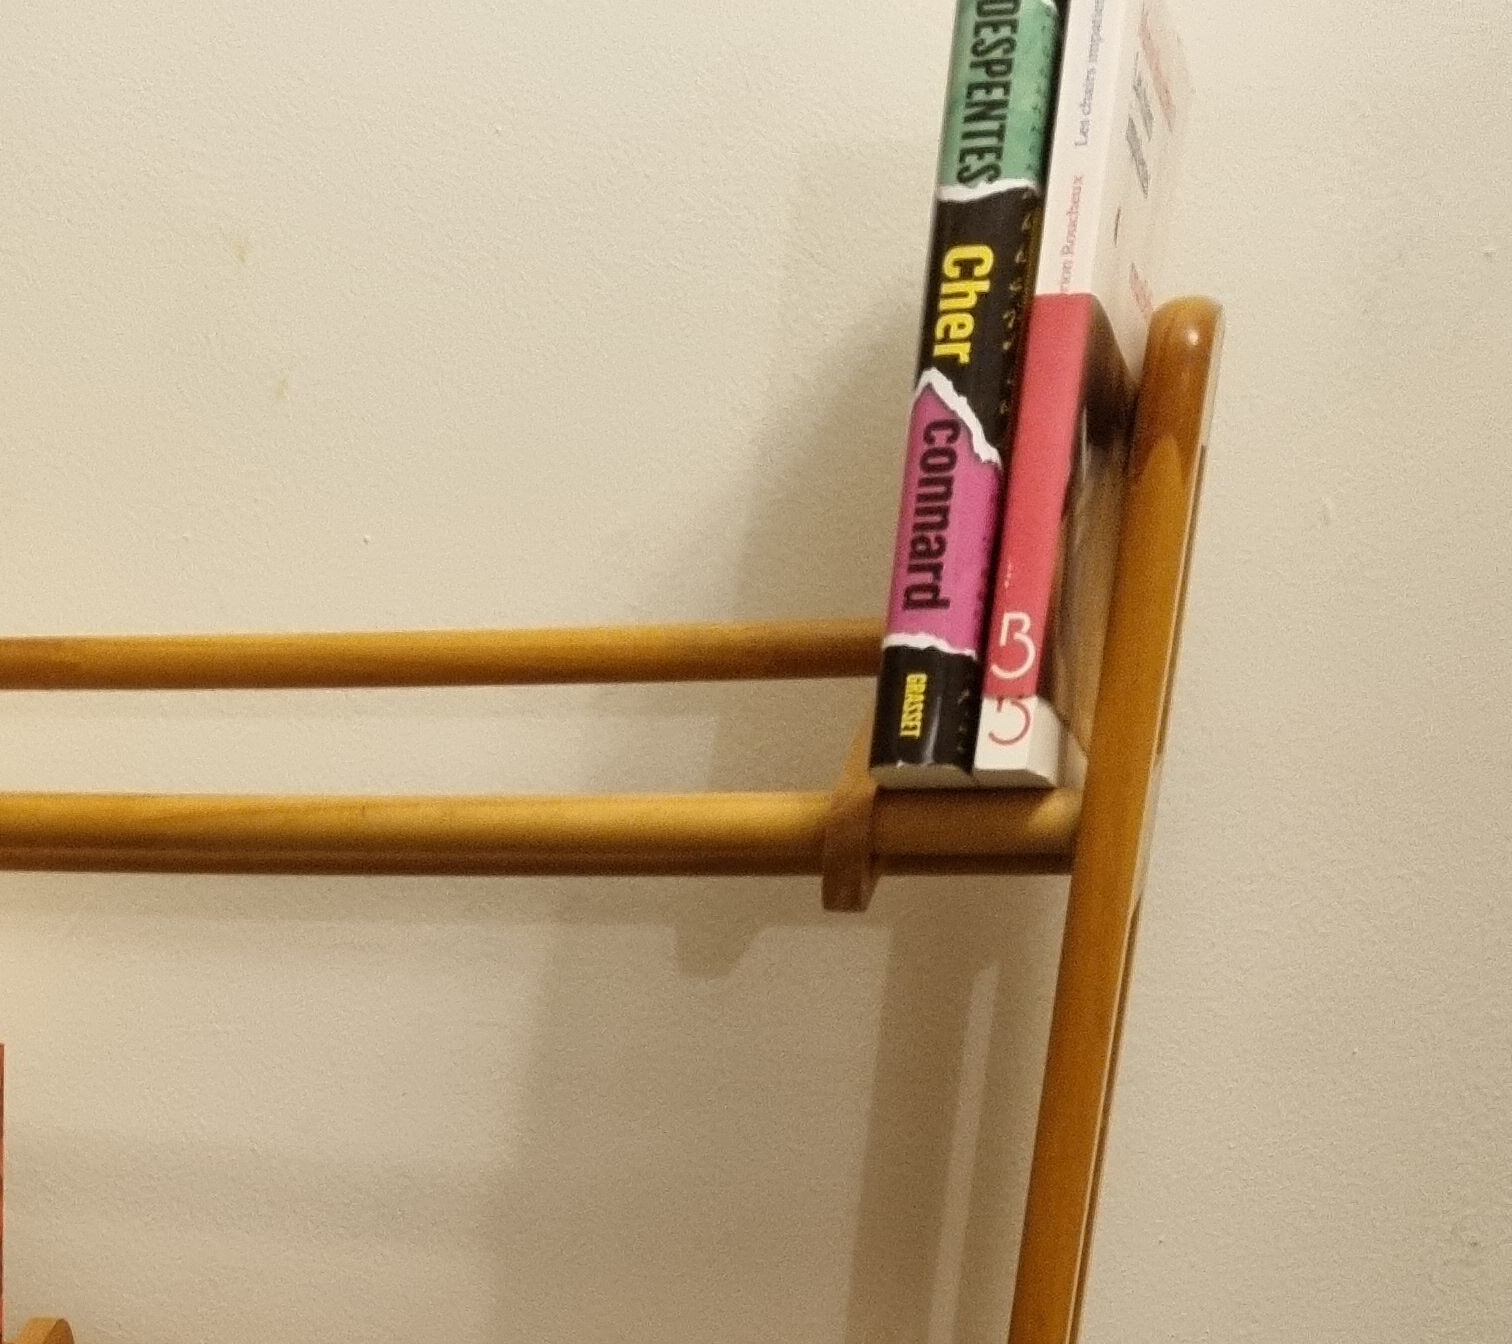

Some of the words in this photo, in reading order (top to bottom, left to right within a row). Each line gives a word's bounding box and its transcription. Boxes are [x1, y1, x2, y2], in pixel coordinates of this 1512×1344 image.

[956, 0, 1022, 185] DESPENTES
[932, 243, 995, 366] Cher
[902, 418, 963, 611] connard
